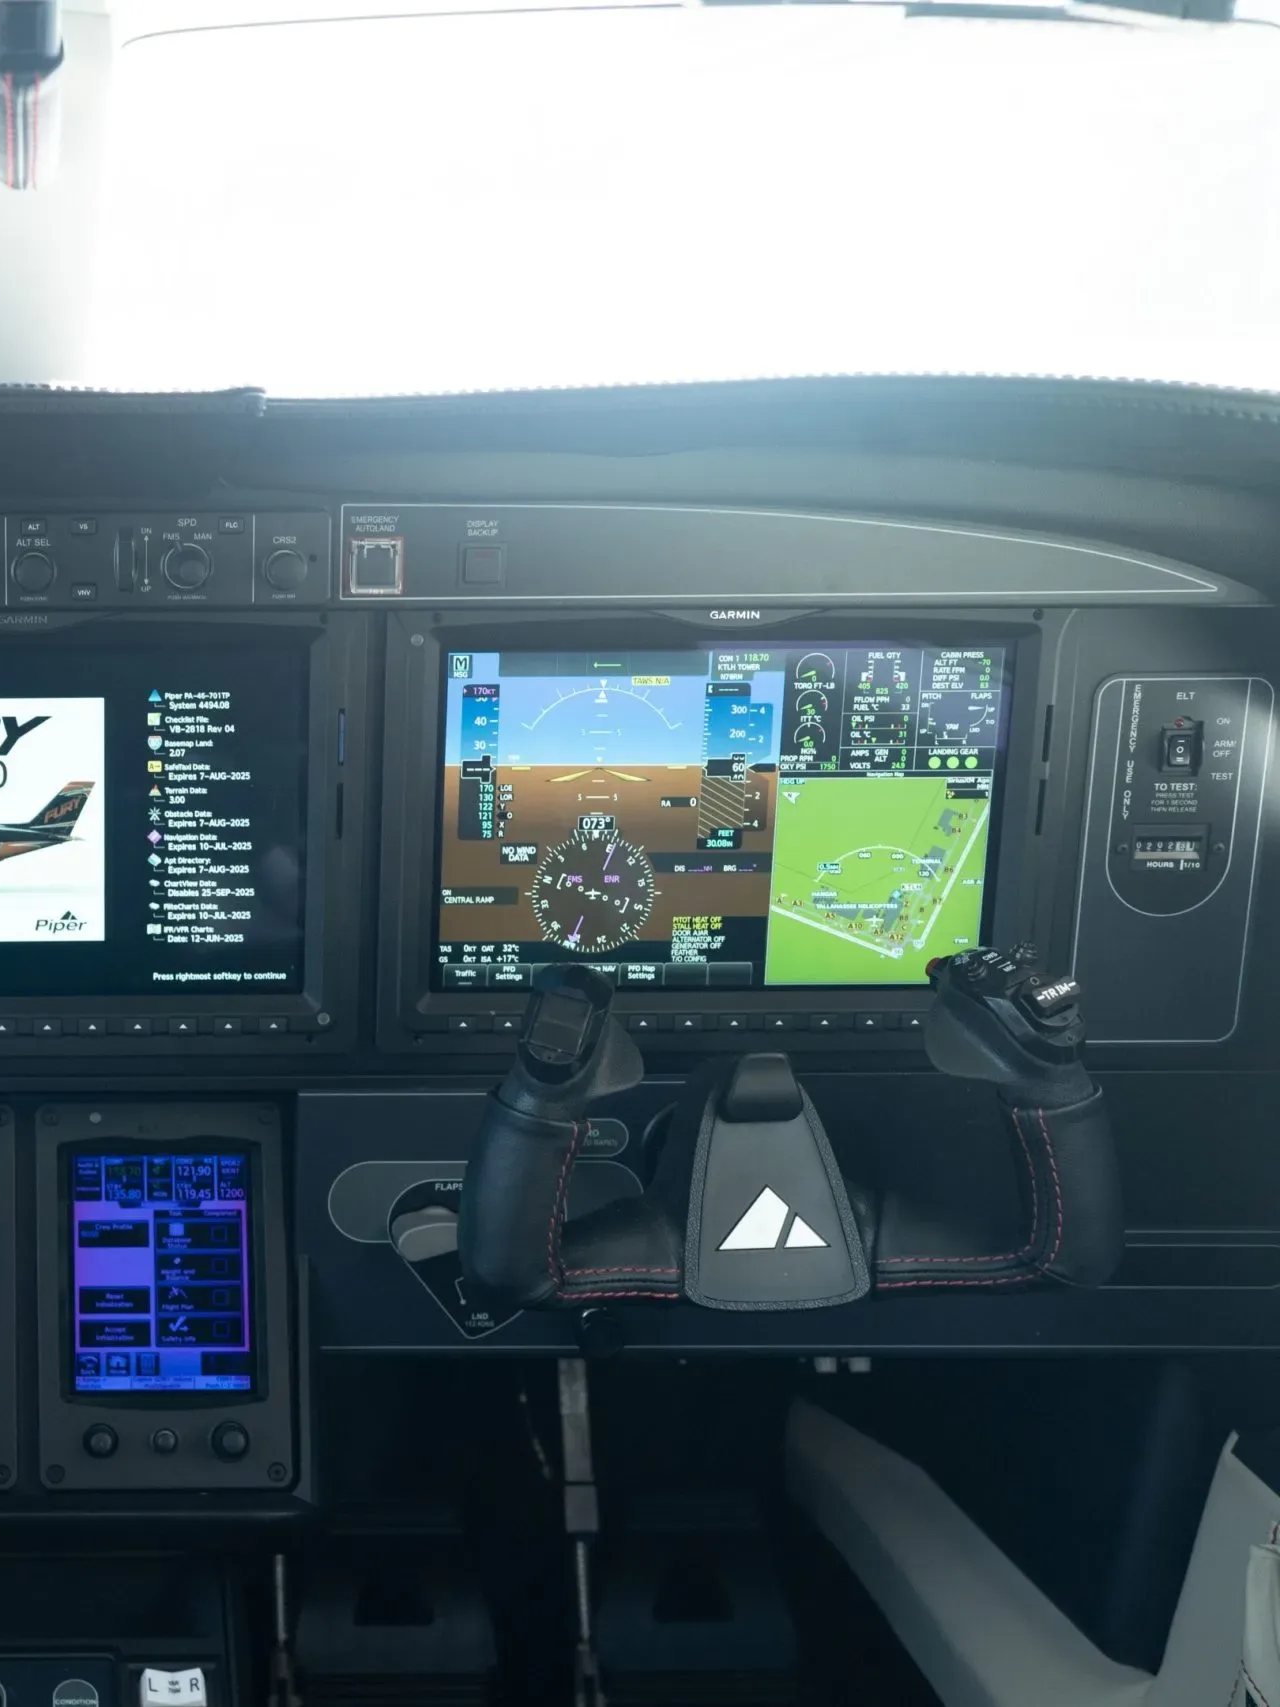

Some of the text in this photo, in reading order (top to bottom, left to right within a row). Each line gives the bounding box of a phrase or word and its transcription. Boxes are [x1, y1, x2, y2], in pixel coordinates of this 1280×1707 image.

[177, 519, 196, 527] SPD
[351, 516, 400, 524] EMERGENCY
[466, 520, 500, 528] DISPLAY
[356, 524, 396, 532] AUTOLAND
[467, 528, 499, 537] BACKUP
[163, 533, 180, 541] FMS
[194, 533, 212, 541] MAN
[272, 536, 297, 544] CRS2
[16, 538, 51, 547] ALT SEL
[710, 610, 760, 620] GARMIN
[743, 653, 769, 662] 118.70
[165, 692, 182, 701] Piper
[1176, 692, 1196, 700] ELT
[169, 701, 230, 710] System 4494.08
[731, 705, 747, 715] 300
[474, 716, 487, 726] 40
[225, 725, 235, 733] 04
[729, 729, 746, 739] 200
[165, 740, 194, 748] Basemap
[473, 740, 486, 750] 30
[169, 749, 185, 757] 2.07
[732, 762, 744, 772] 60
[1125, 760, 1134, 783] USE
[168, 772, 251, 781] Expires 7-AUG-2025
[1154, 783, 1197, 791] TO TEST:
[169, 796, 185, 804] 3.00
[1122, 790, 1132, 820] ONLY
[44, 798, 81, 824] FURY
[168, 819, 250, 828] Expires 7-AUG-2025
[164, 834, 198, 842] Navigation
[168, 842, 252, 851] Expires 10-JUL-2025
[502, 846, 537, 855] NO WIND
[164, 857, 211, 865] Apt Directory:
[509, 854, 528, 862] DATA
[168, 866, 196, 875] Expires
[567, 875, 583, 884] FMS
[604, 875, 620, 884] ENR
[168, 889, 255, 897] Disables 25-SEP-2025
[444, 896, 495, 905] CENTRAL RAMP
[168, 912, 196, 921] Expires
[35, 918, 87, 934] Piper
[153, 972, 287, 982] Press rightmost softkey to continue
[1042, 982, 1071, 1001] TRIM
[177, 1166, 211, 1176] 121.90
[177, 1189, 211, 1200] 119.45
[220, 1188, 245, 1199] 1200
[148, 1678, 159, 1692] L
[190, 1678, 200, 1691] R
